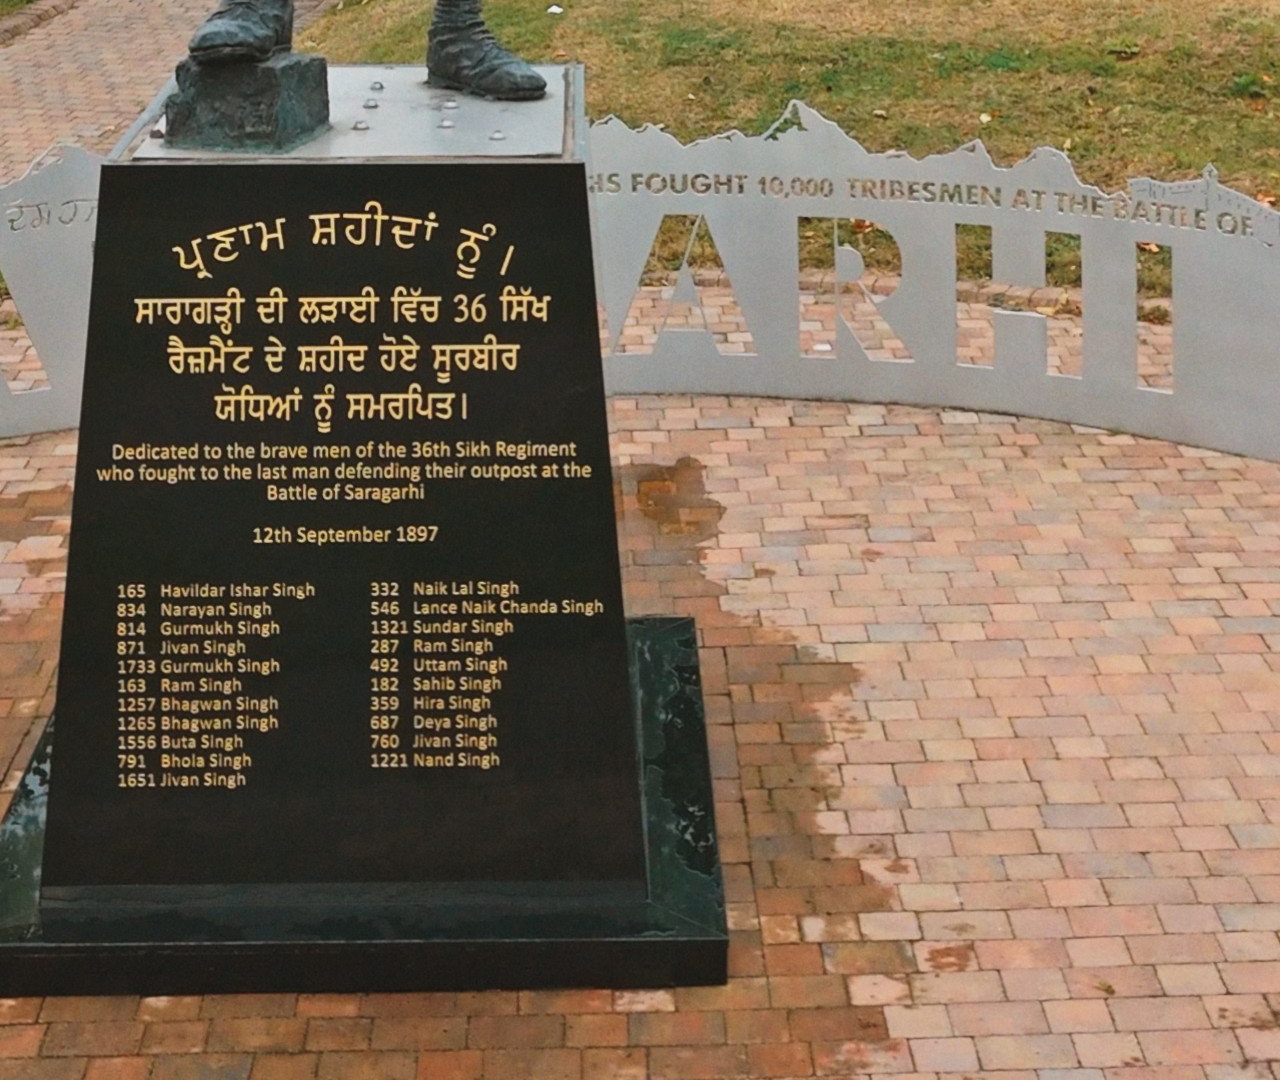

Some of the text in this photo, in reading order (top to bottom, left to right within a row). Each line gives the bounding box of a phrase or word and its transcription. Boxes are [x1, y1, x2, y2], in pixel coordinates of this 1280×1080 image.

[630, 173, 748, 195] FOUGHT
[757, 175, 834, 199] 10,000
[847, 178, 1002, 208] TRIBESMEN
[1010, 188, 1047, 212] AT
[1053, 190, 1105, 218] THE
[1114, 197, 1208, 231] BATTLE
[1216, 211, 1254, 236] OF
[308, 200, 440, 250] ਸ਼ਹੀਦਾਂ
[255, 286, 289, 324] ਦੀ
[297, 285, 381, 324] ਲੜਾਈ
[389, 285, 443, 324] ਵਿੱਚ
[453, 293, 487, 323] 36
[498, 284, 552, 323] ਸਿੱਖ
[263, 335, 287, 373] ਦੇ
[296, 334, 369, 373] ਸ਼ਹੀਦ
[378, 332, 421, 372] ਹੋਏ
[430, 333, 521, 384] ਸੂਰਬੀਰ
[213, 382, 304, 422] ਯੋਧਿਆਂ
[112, 441, 576, 461] Dedicated to the brave men of the 36th Sikh Regiment
[97, 461, 591, 483] who fought to the last man defending their outpost at the
[267, 483, 424, 503] Battle of Saragarhi
[253, 526, 438, 546] 12th September 1897
[117, 581, 316, 600] 165 Havildar Ishar Singh
[370, 580, 520, 599] 332 Naik Lal Singh
[116, 601, 272, 619] 834 Narayan Singh
[370, 599, 604, 617] 546 Lance Naik Chanda Singh
[116, 620, 280, 638] 814 Gurmukh Singh
[371, 618, 514, 637] 1321 Sundar Singh
[116, 639, 246, 657] 871 Jivan Singh
[370, 637, 494, 656] 287 Ram Singh
[117, 657, 280, 676] 1733 Gurmukh Singh
[369, 656, 508, 675] 492 Uttam Singh
[118, 677, 242, 695] 163 Ram Singh
[370, 675, 502, 694] 182 Sahib Singh
[118, 695, 279, 714] 1257 Bhagwan Singh
[370, 694, 491, 713] 359 Hira Singh
[117, 714, 279, 733] 1265 Bhagwan Singh
[370, 713, 498, 732] 687 Deya Singh
[118, 734, 244, 752] 1556 Buta Singh
[370, 732, 498, 751] 760 Jivan Singh
[117, 752, 252, 771] 791 Bhola Singh
[370, 751, 500, 770] 1221 Nand Singh
[118, 771, 246, 790] 1651 Jivan Singh
